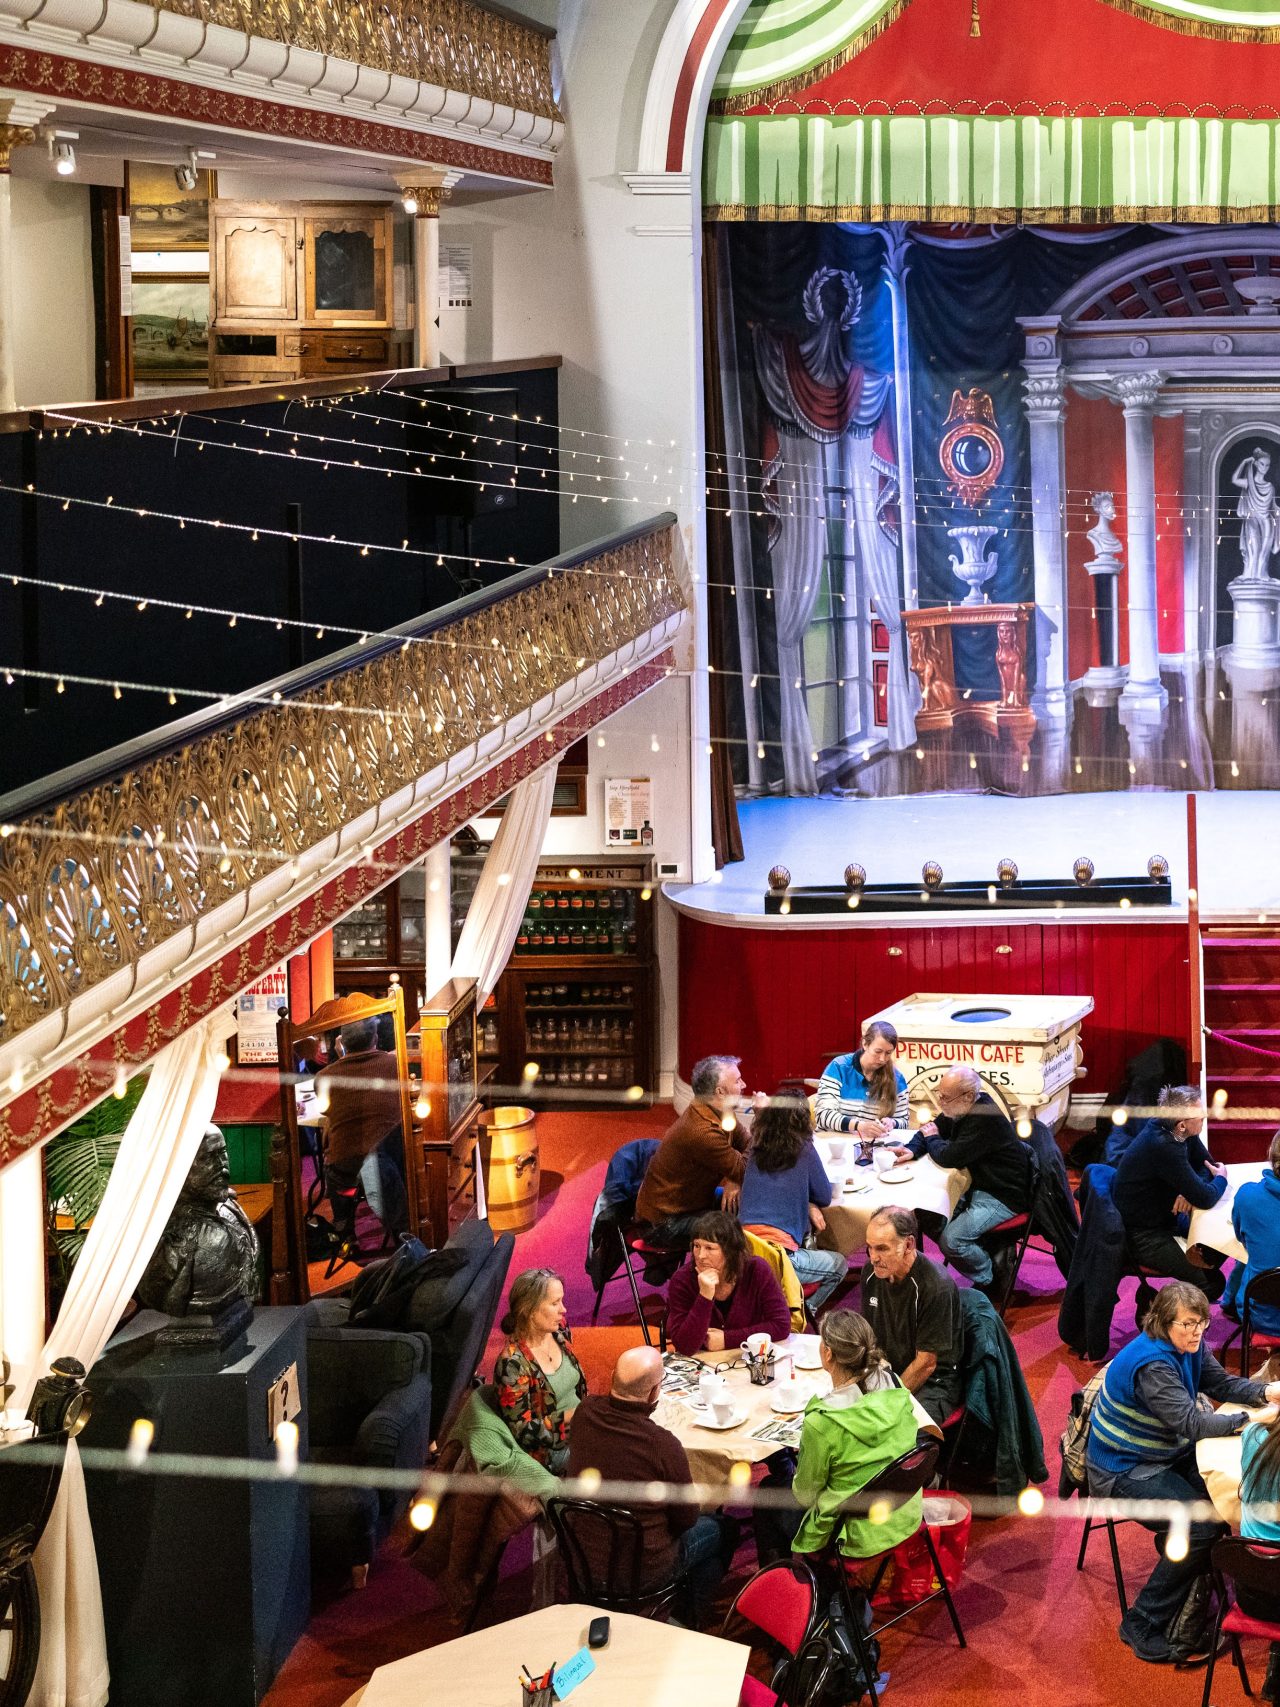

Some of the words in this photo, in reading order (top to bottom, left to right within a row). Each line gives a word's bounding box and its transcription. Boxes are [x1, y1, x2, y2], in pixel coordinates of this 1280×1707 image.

[536, 870, 625, 878] EPAMENT
[245, 973, 286, 994] PERTY
[895, 1041, 974, 1061] PENGUIN
[981, 1044, 1025, 1064] CAFÉ
[556, 1656, 587, 1688] Bilingual
